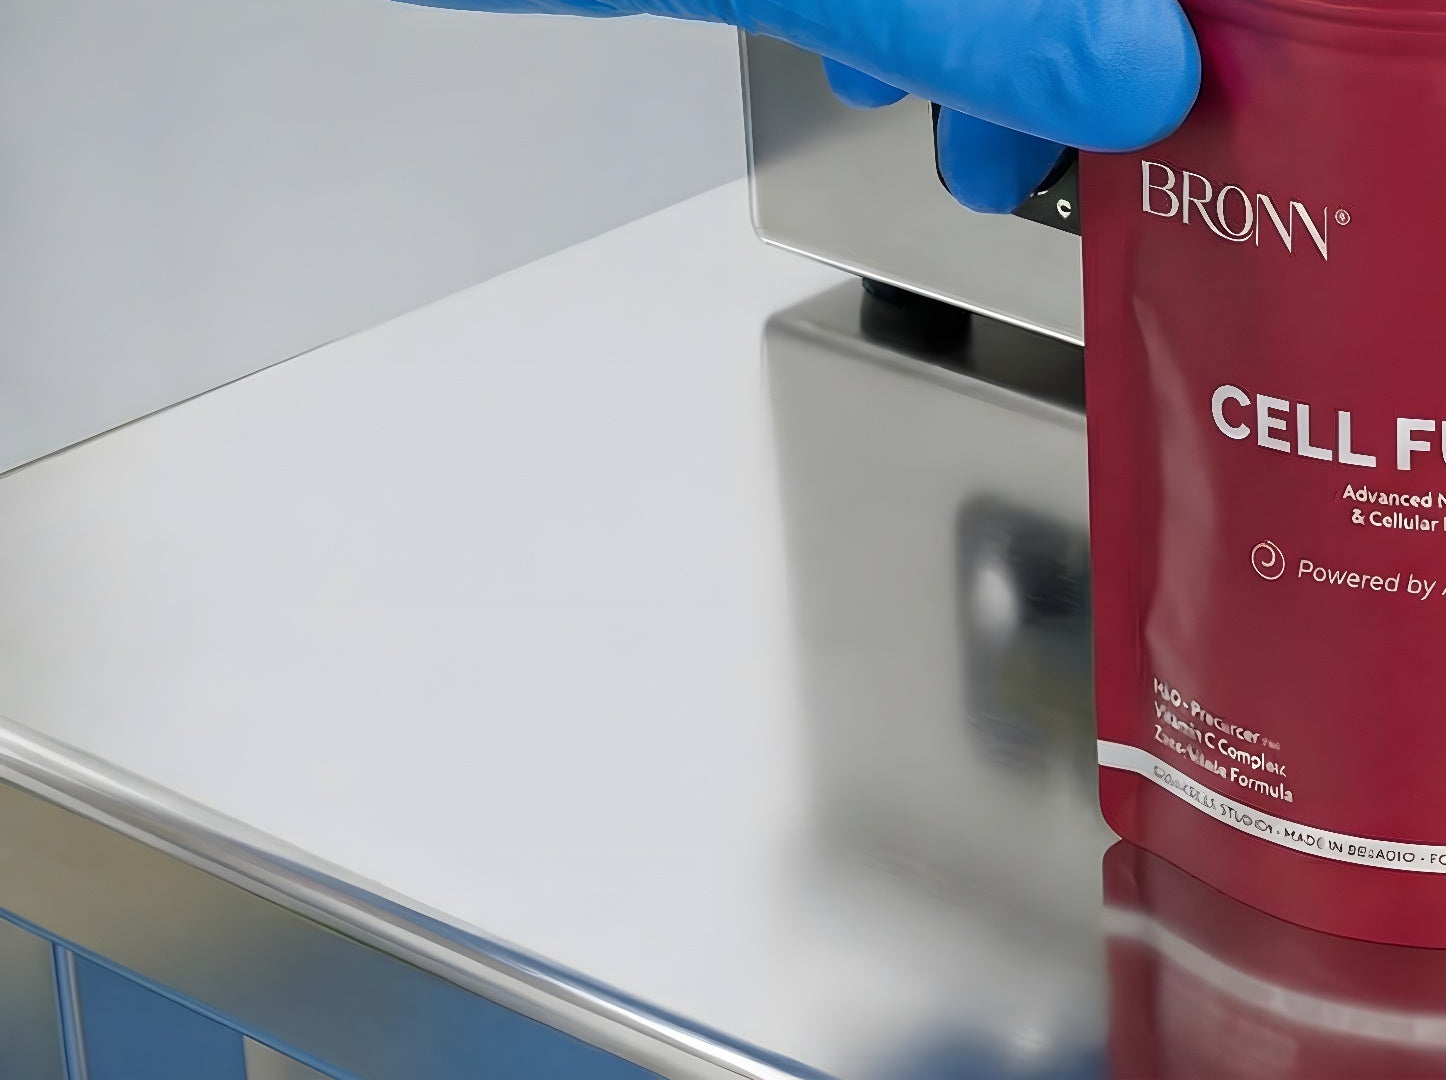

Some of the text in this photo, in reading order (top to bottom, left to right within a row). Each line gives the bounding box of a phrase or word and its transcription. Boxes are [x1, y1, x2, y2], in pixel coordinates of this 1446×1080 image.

[1211, 384, 1376, 468] CELL
[1342, 484, 1432, 508] Advanced
[1351, 508, 1365, 526] &
[1370, 510, 1438, 532] Cellular
[1298, 560, 1400, 593] Powered
[1407, 574, 1436, 600] by
[1230, 767, 1294, 803] Formula
